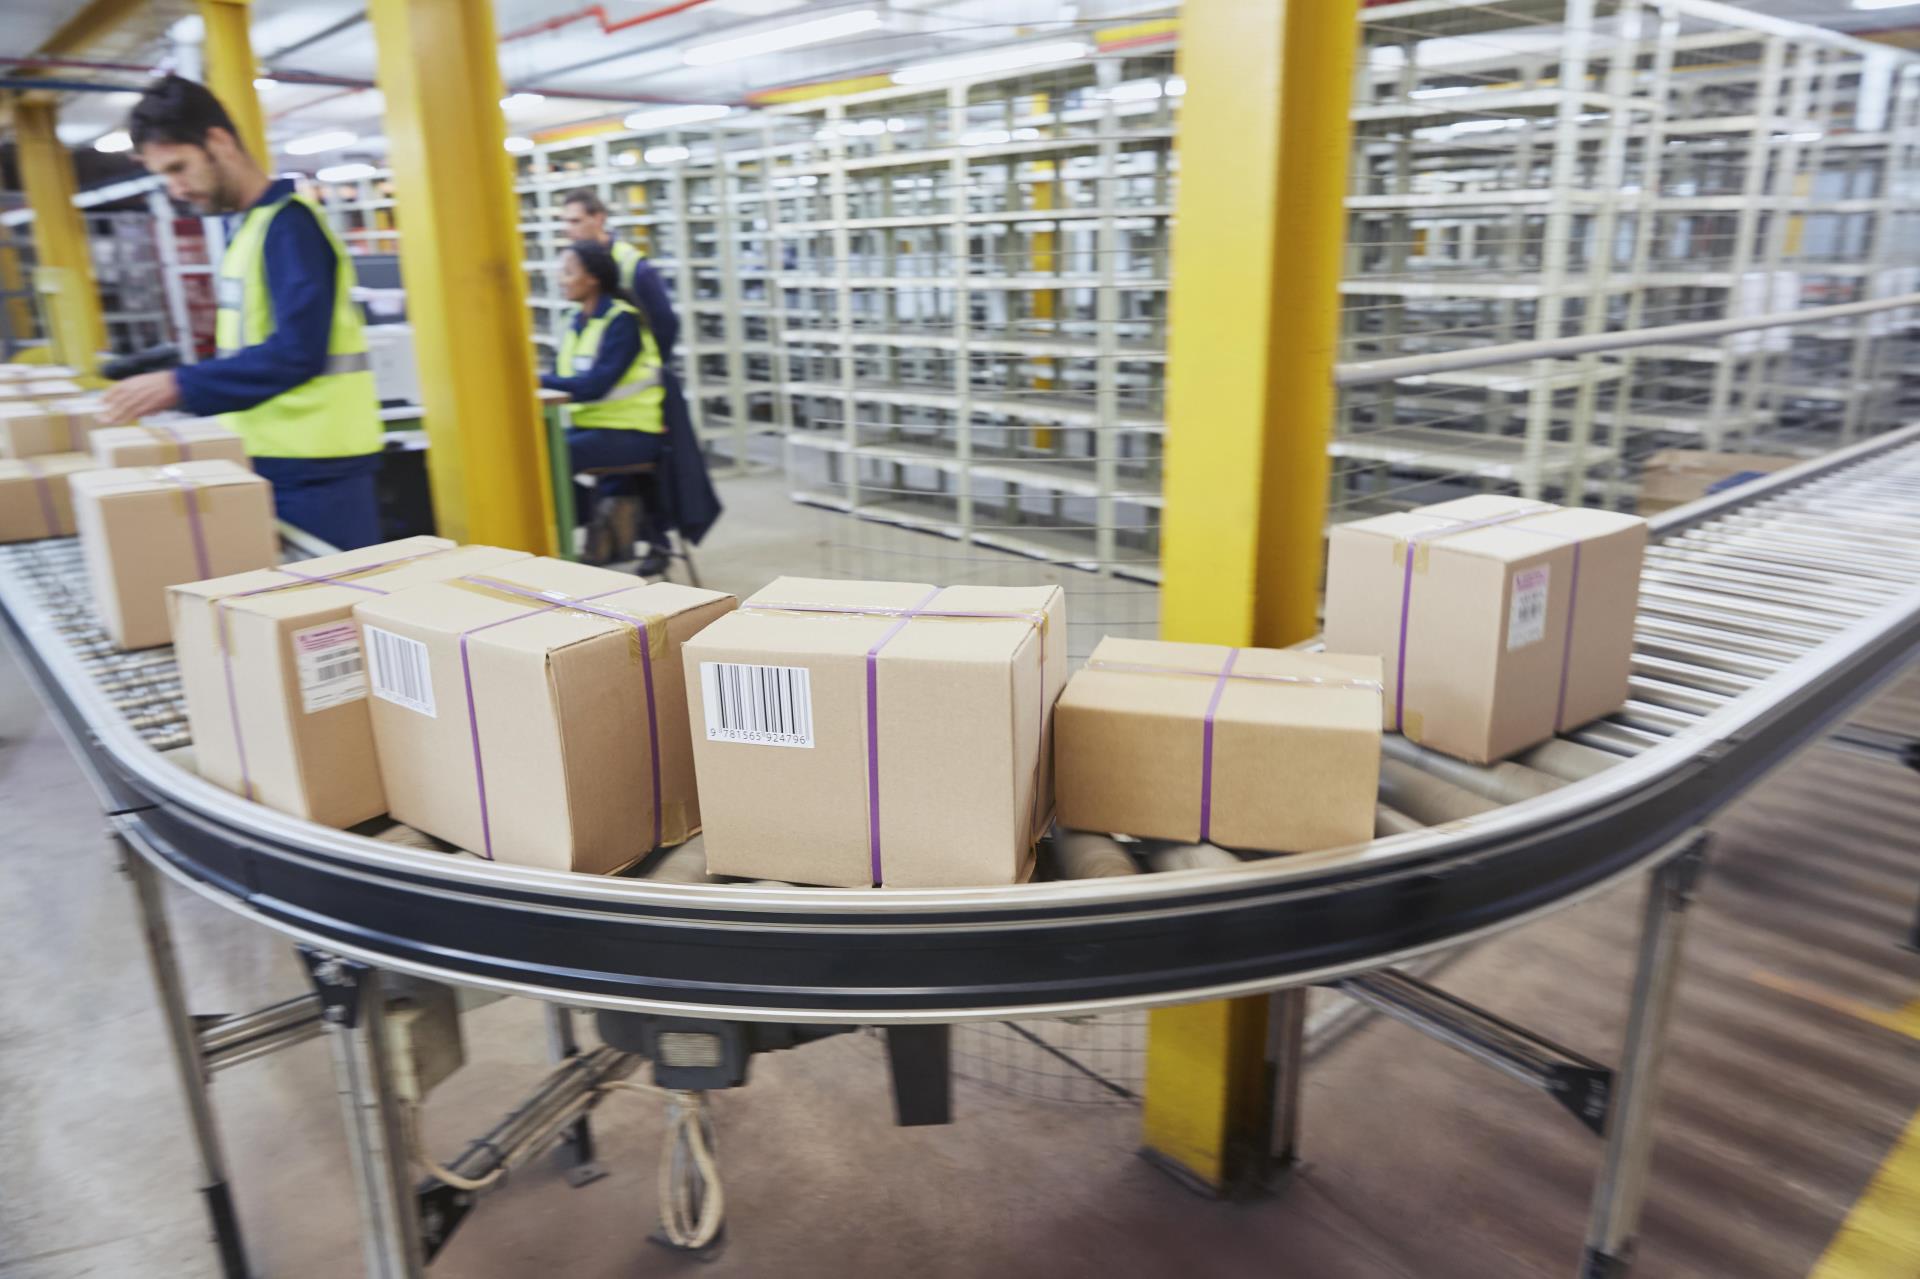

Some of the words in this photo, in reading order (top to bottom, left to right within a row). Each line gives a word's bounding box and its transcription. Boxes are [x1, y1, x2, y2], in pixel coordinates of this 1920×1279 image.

[711, 728, 717, 737] 9
[723, 730, 761, 741] 781565
[766, 733, 807, 744] 924796
